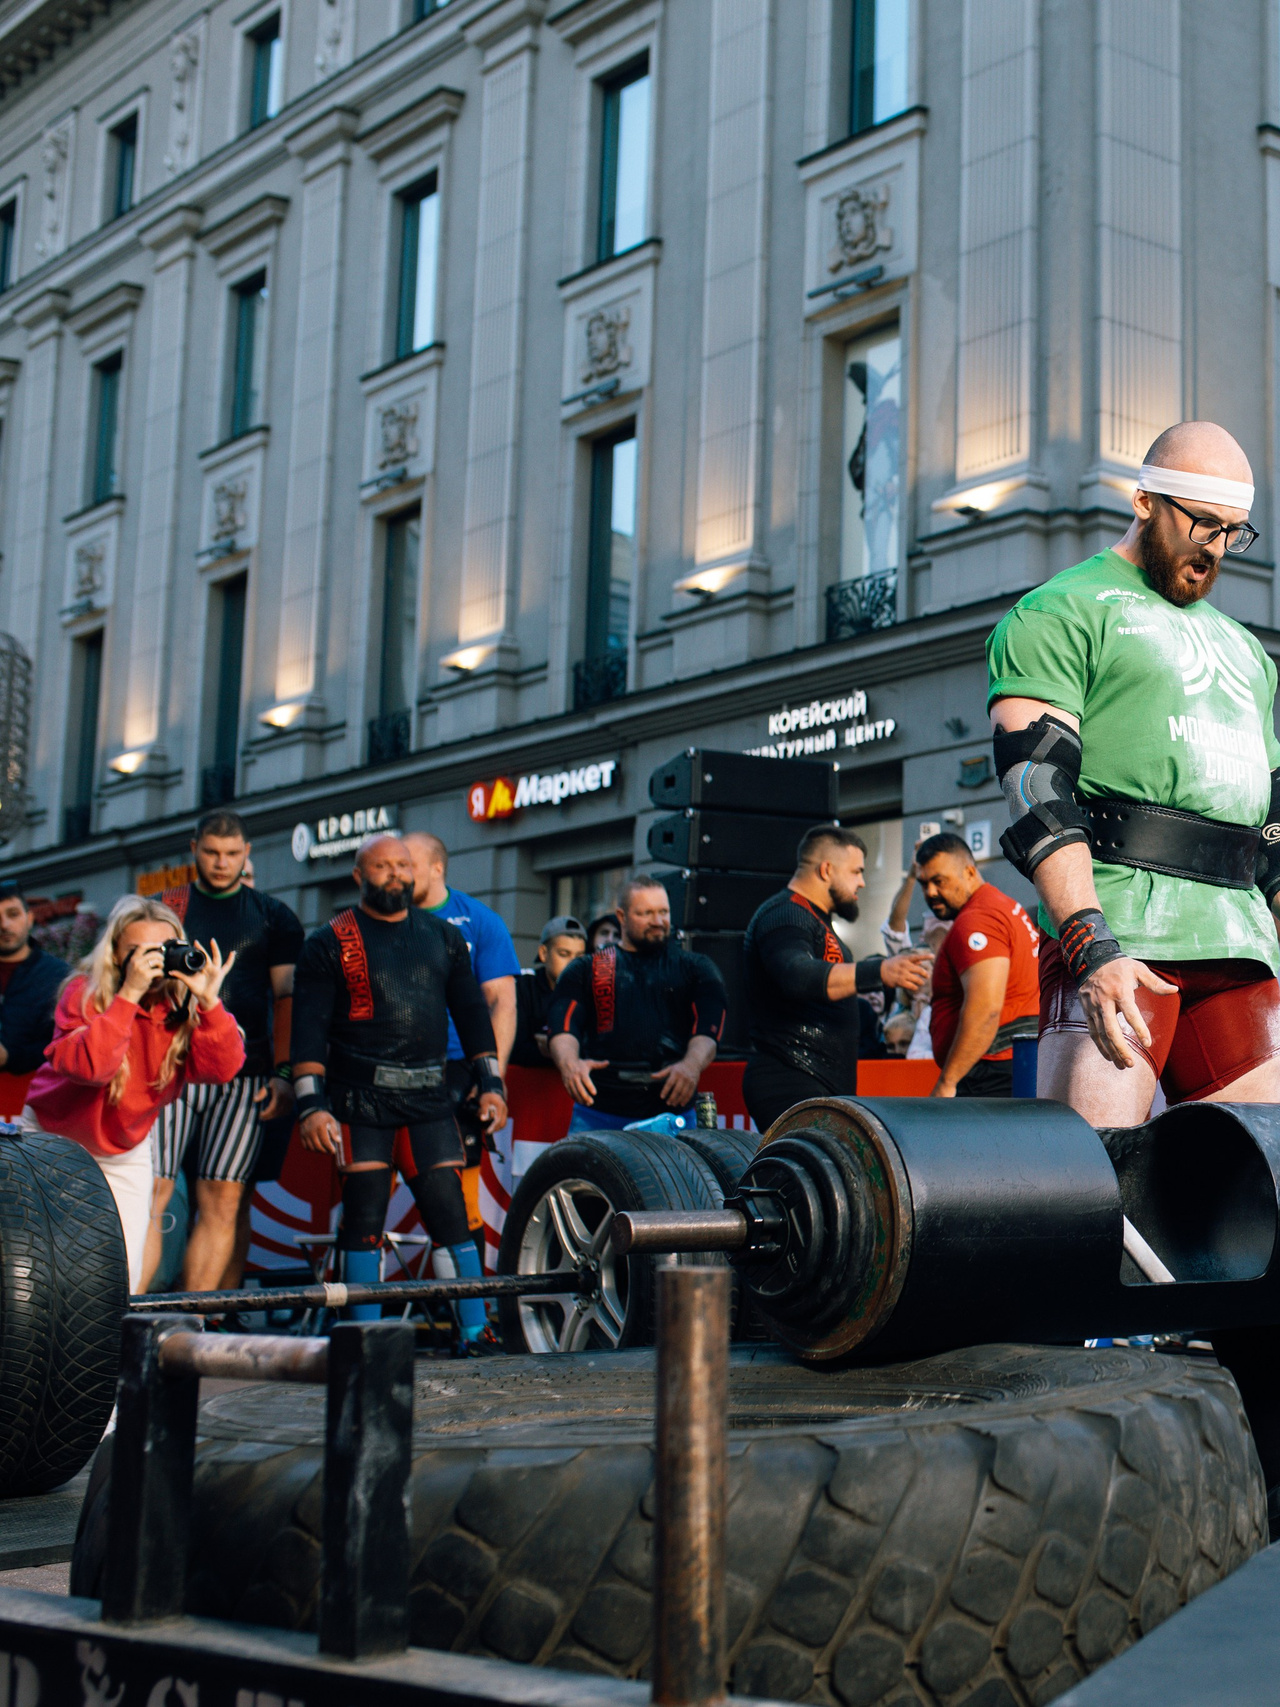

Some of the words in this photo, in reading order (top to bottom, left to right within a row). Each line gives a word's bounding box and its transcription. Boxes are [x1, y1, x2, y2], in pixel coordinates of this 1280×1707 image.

[769, 689, 868, 736] КОРЕЙСКИЙ
[845, 718, 896, 747] ЦЕНТР
[1168, 715, 1269, 770] МОСКОВСК
[513, 760, 617, 809] Маркет
[318, 806, 390, 842] КРОПКА
[337, 923, 373, 1020] STRONGMAN
